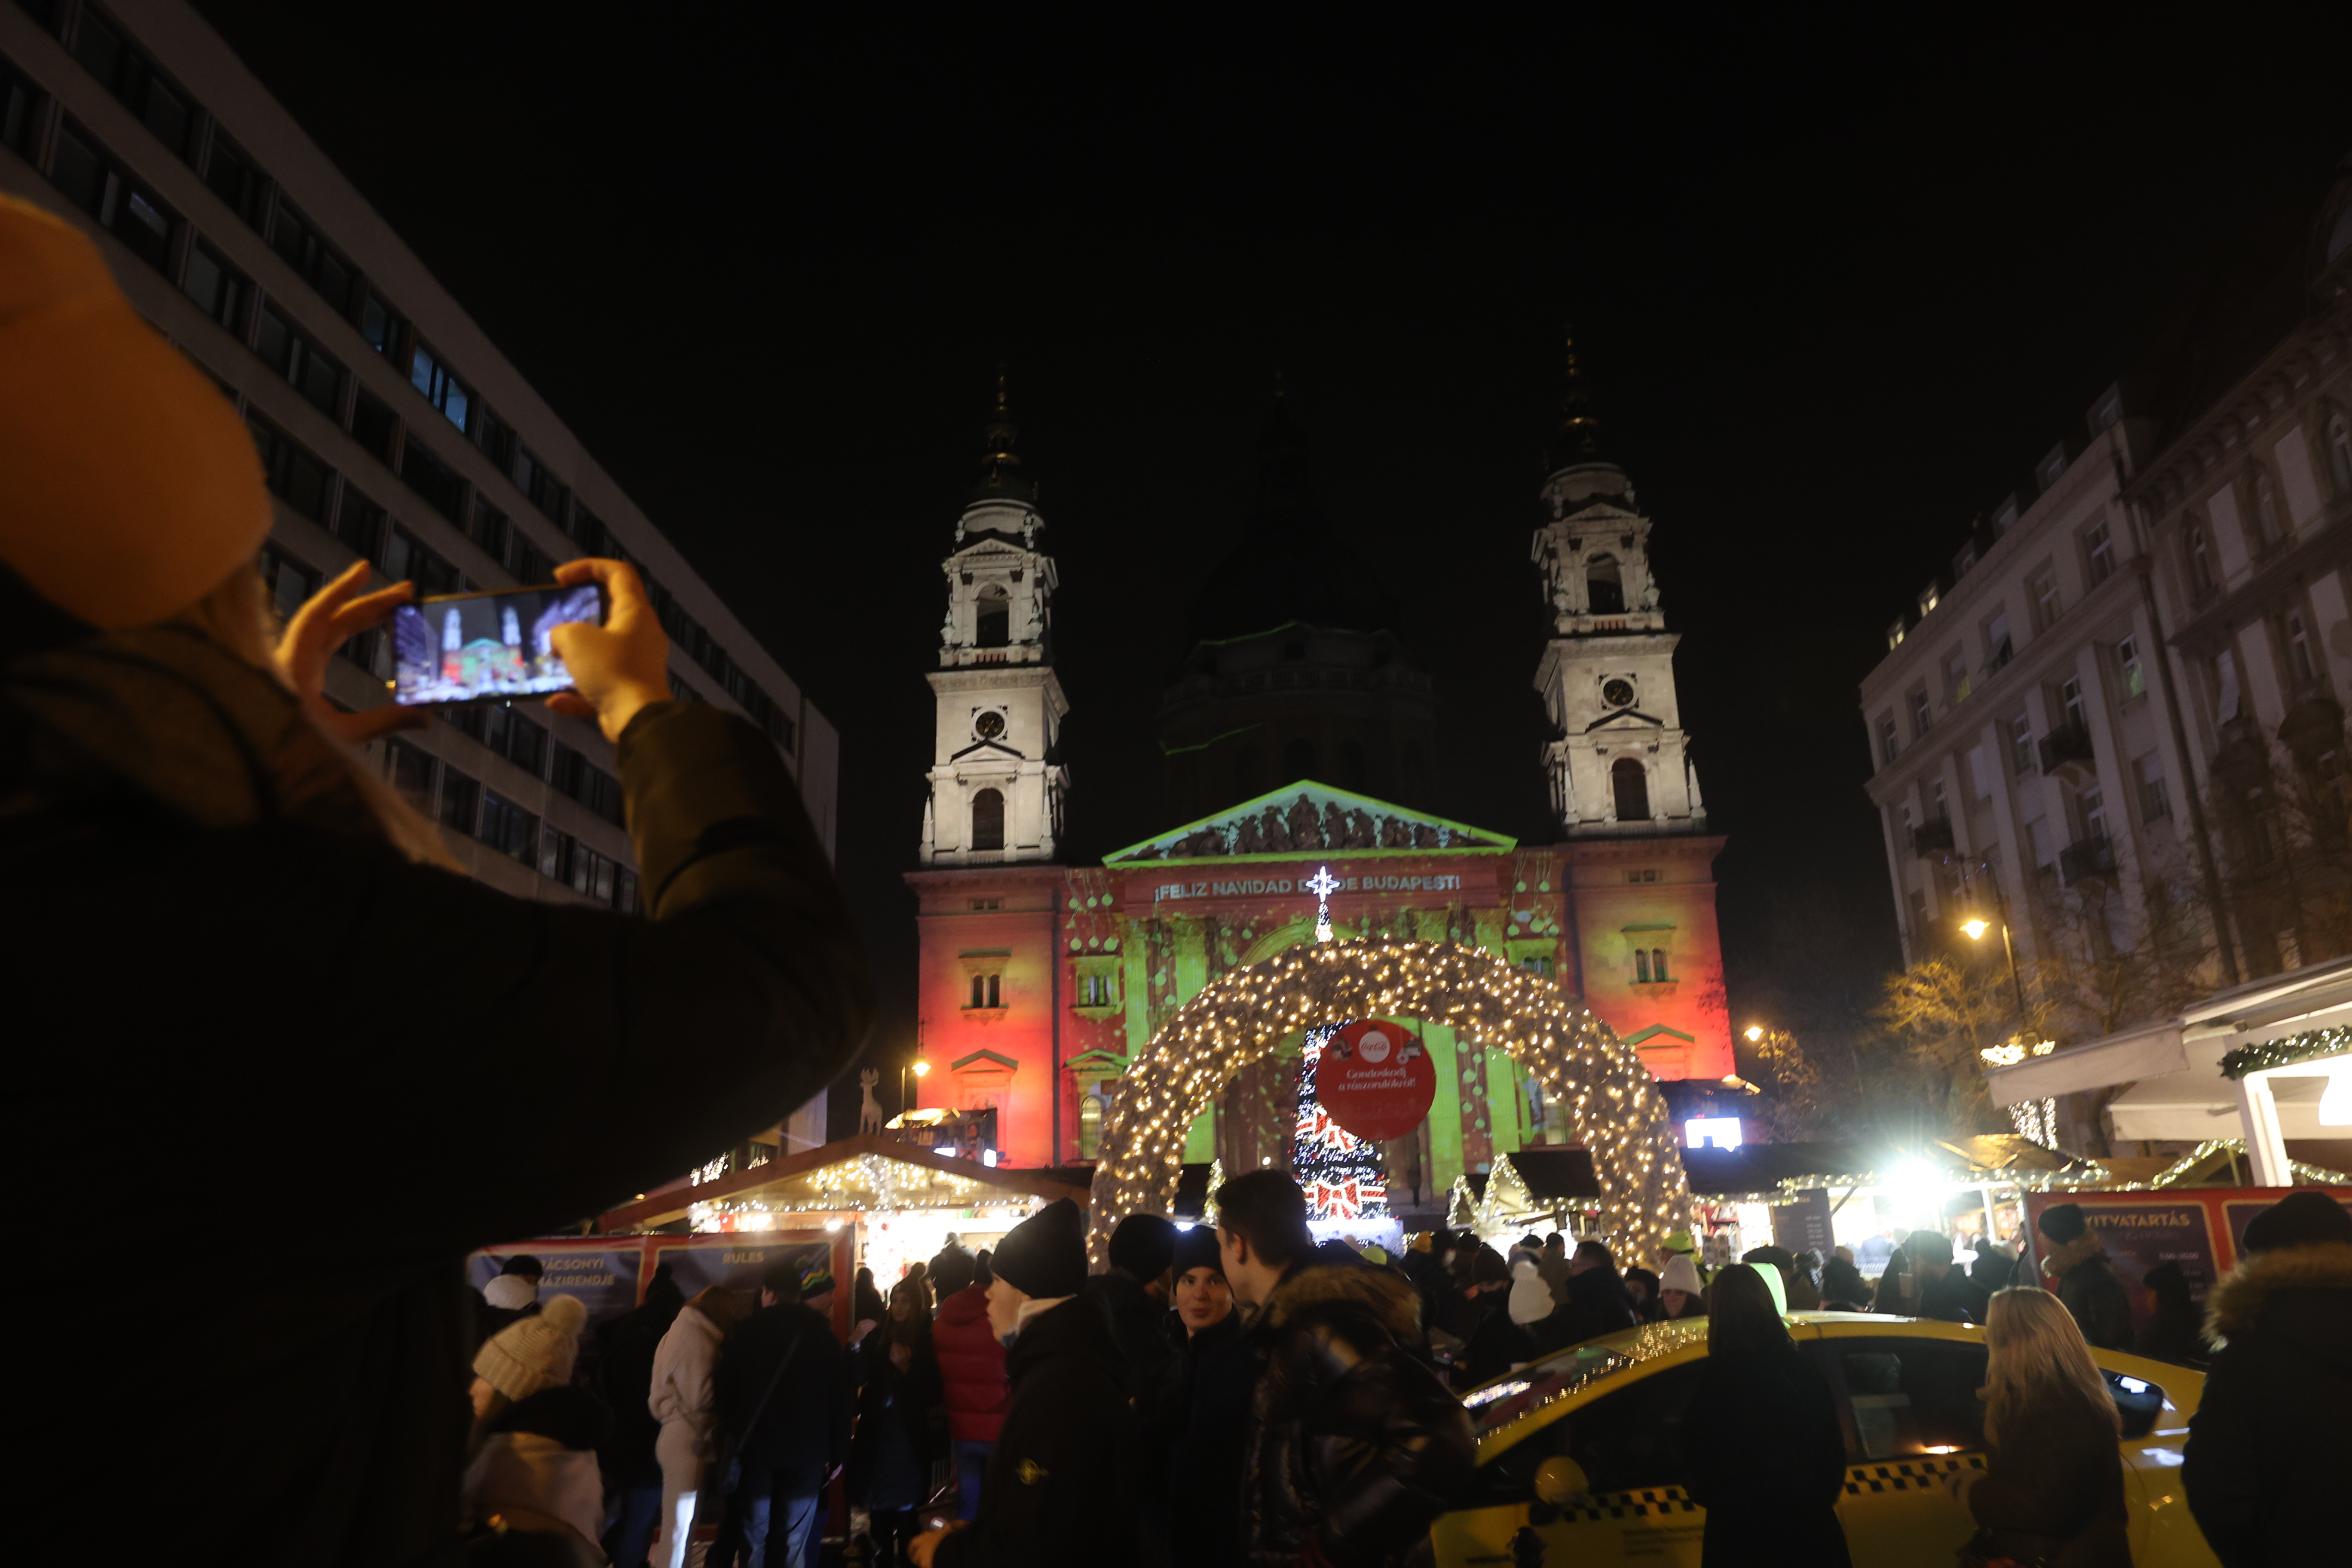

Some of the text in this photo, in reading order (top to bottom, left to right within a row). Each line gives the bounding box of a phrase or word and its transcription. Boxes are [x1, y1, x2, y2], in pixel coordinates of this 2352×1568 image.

[1212, 879, 1292, 896] NAVIDAD
[1297, 877, 1358, 892] DDE
[1362, 875, 1461, 891] BUDAPEST!
[2084, 1210, 2191, 1227] YITVATARTÁS
[723, 1251, 765, 1264] RULES
